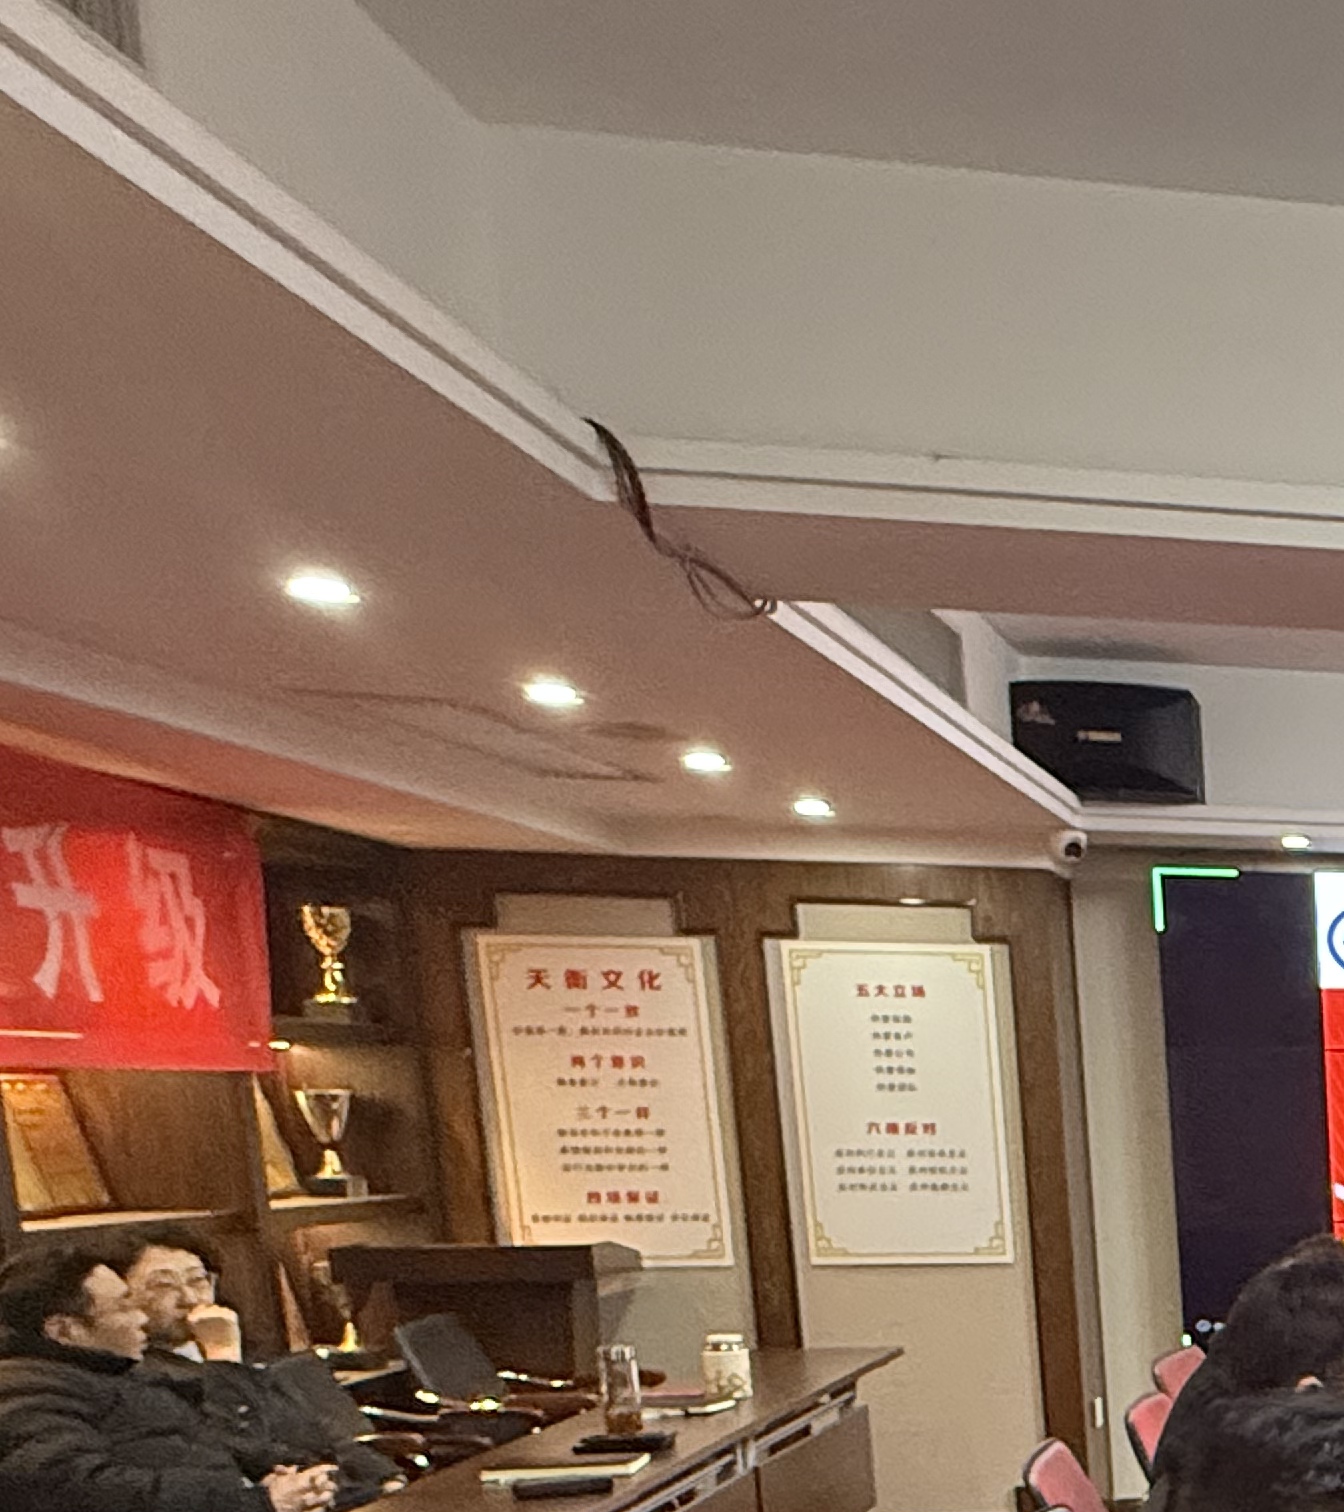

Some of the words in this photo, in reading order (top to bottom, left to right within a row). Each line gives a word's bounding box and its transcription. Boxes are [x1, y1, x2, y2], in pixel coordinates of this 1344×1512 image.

[1, 820, 222, 1010] 升级
[526, 968, 662, 991] 天衡文化
